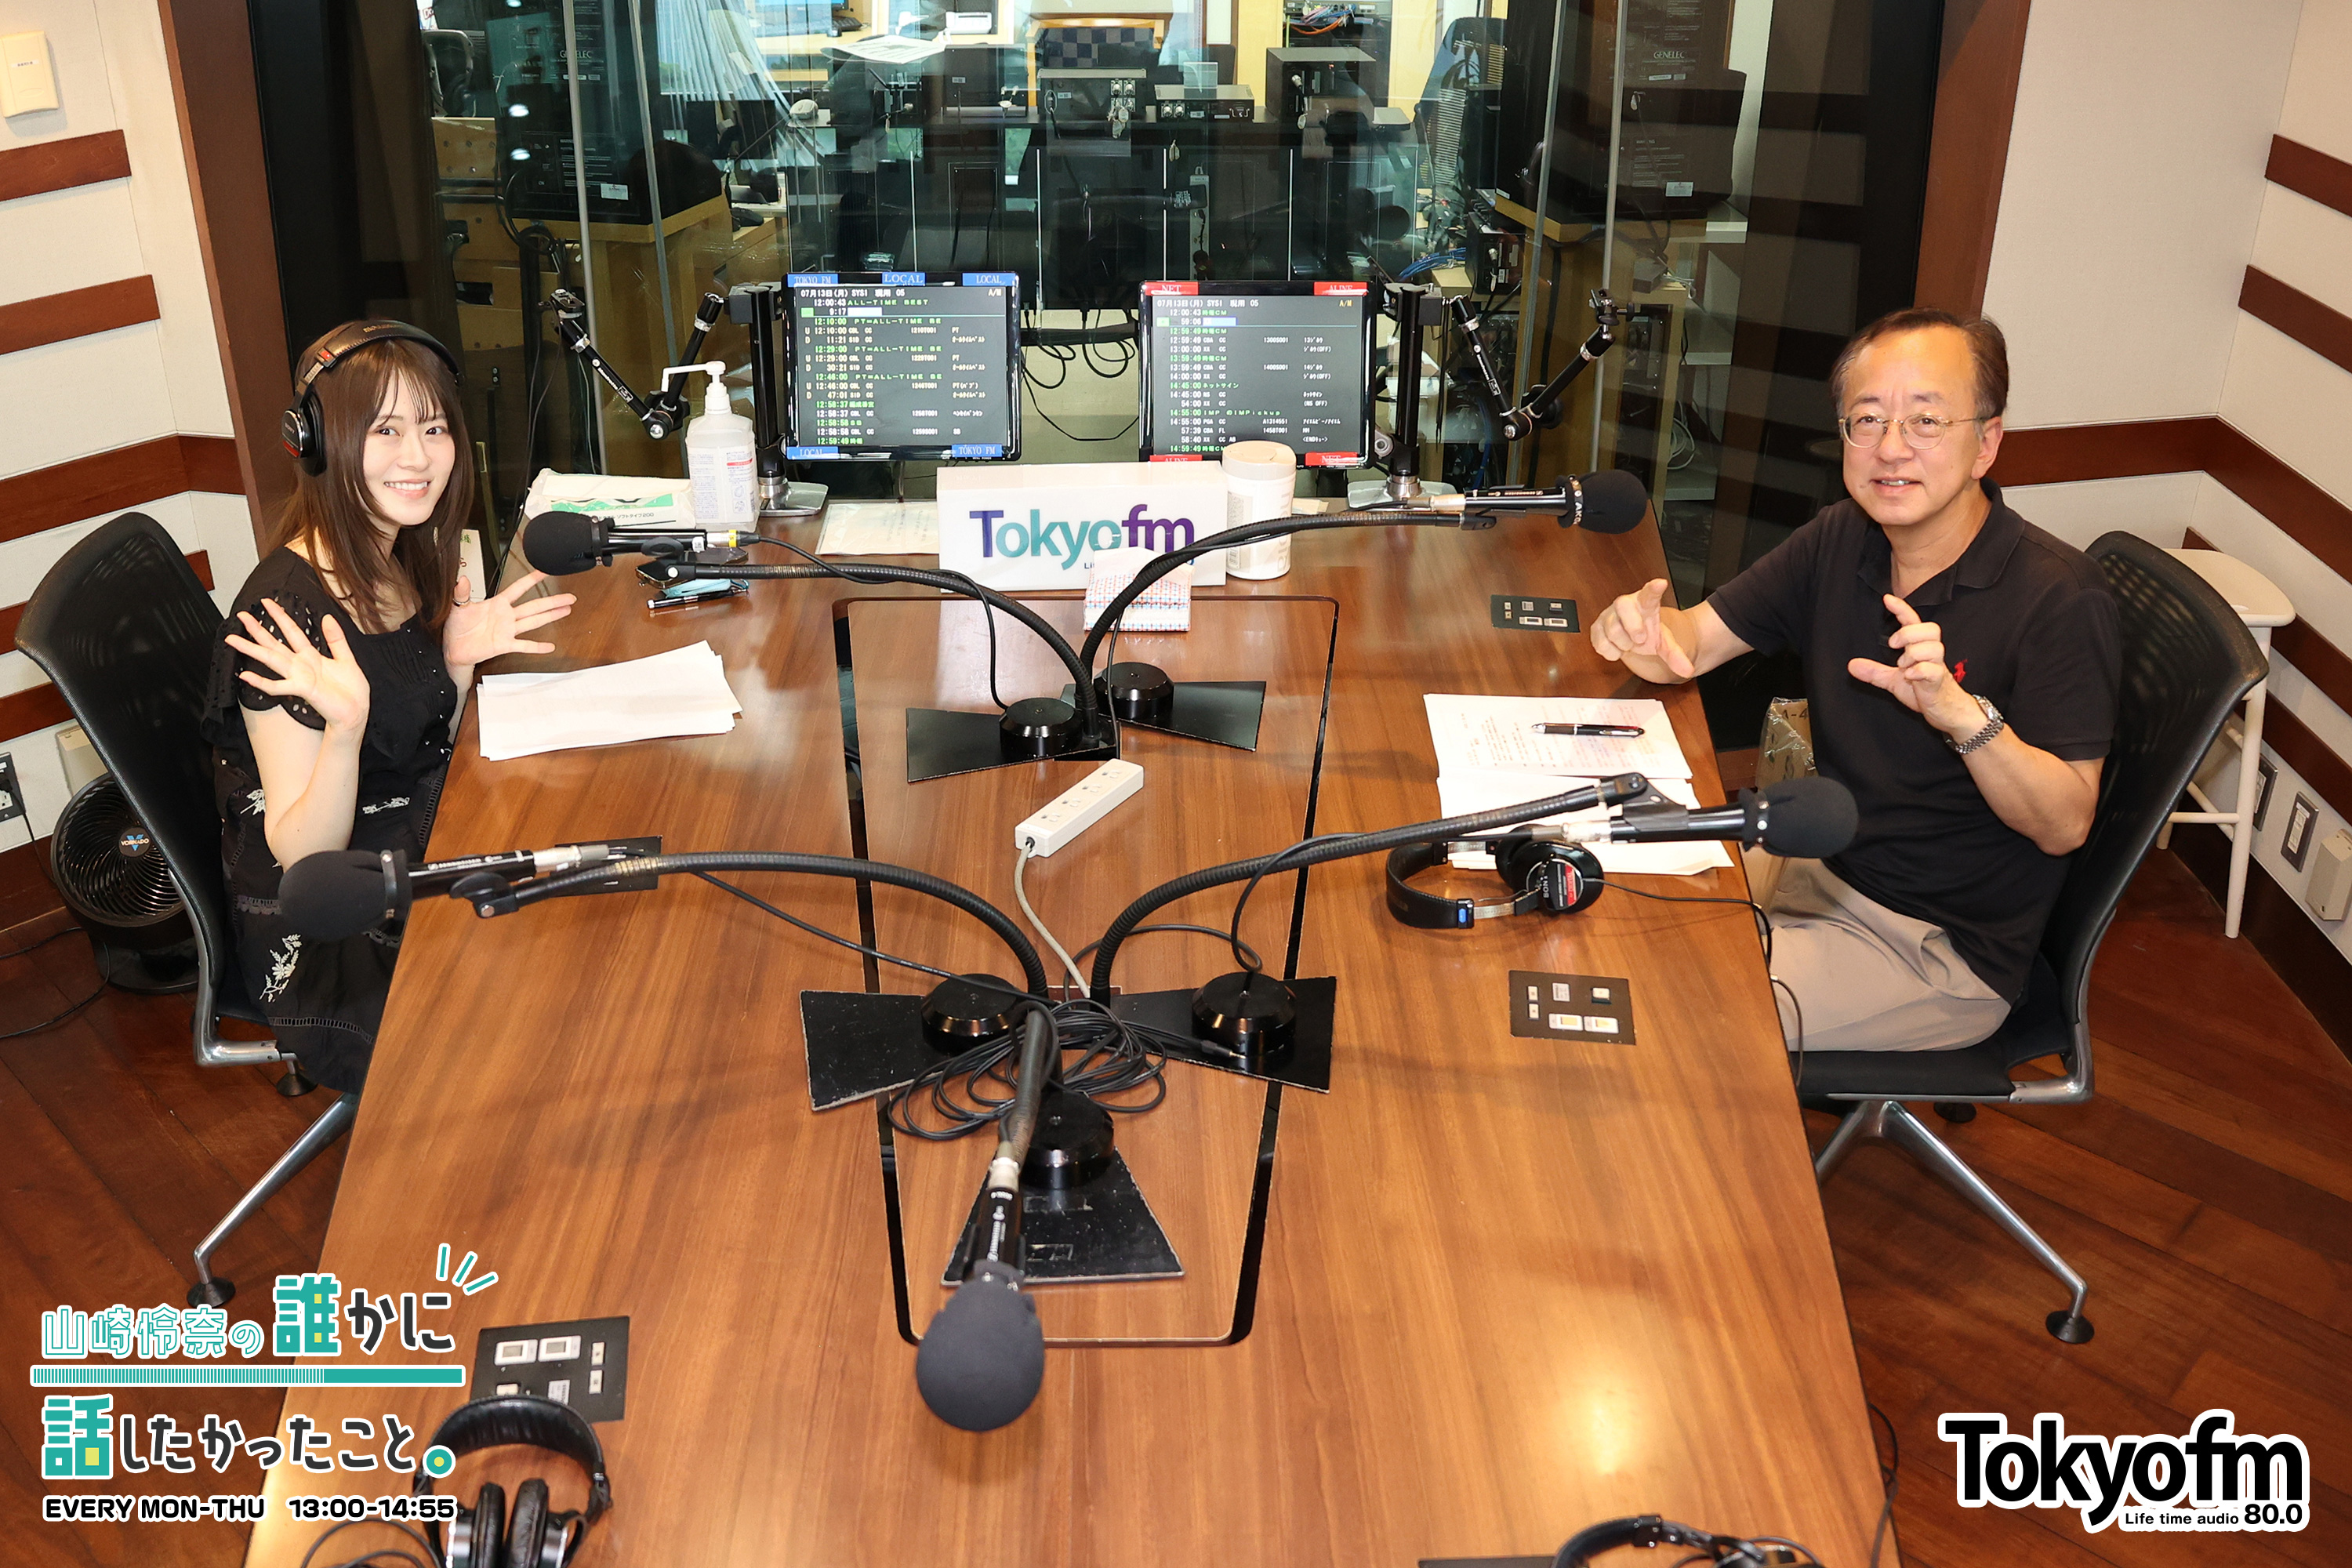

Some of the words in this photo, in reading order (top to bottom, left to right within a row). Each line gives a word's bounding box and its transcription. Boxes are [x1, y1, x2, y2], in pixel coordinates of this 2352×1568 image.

[560, 49, 593, 59] GELEC
[1653, 50, 1686, 60] GENELEC
[959, 446, 982, 455] TOKYO
[969, 504, 1195, 570] Tokyofm
[121, 837, 150, 846] VORNADO
